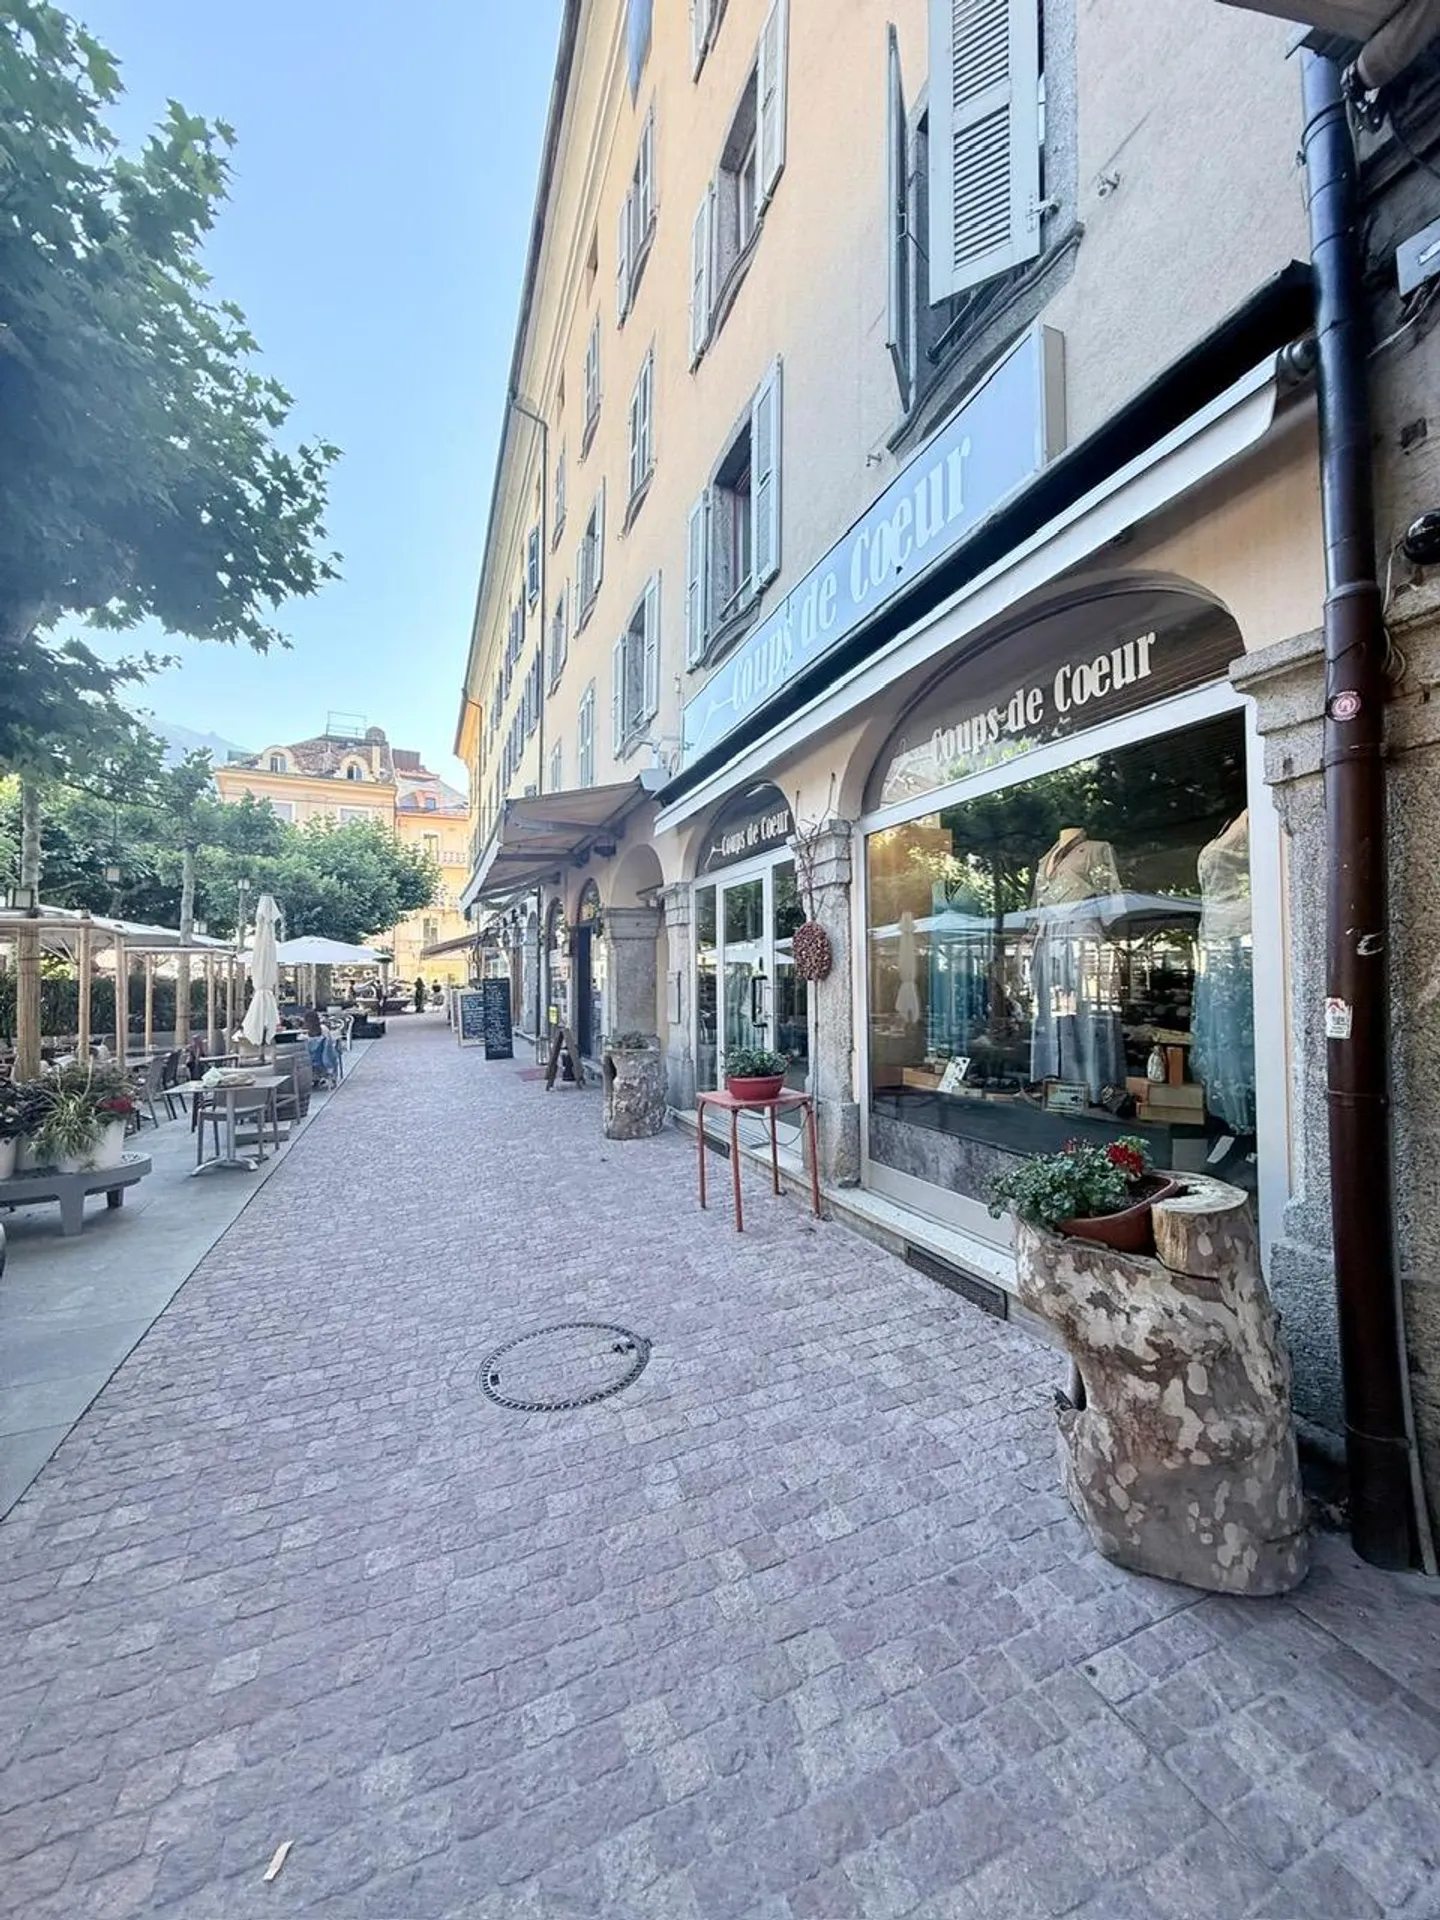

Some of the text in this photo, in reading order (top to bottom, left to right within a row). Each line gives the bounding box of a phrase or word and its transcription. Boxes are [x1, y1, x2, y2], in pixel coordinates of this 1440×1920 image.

[732, 436, 971, 710] Coups de Coeur
[932, 631, 1156, 763] Coups de Coeur
[722, 809, 789, 856] Coups de Coeur
